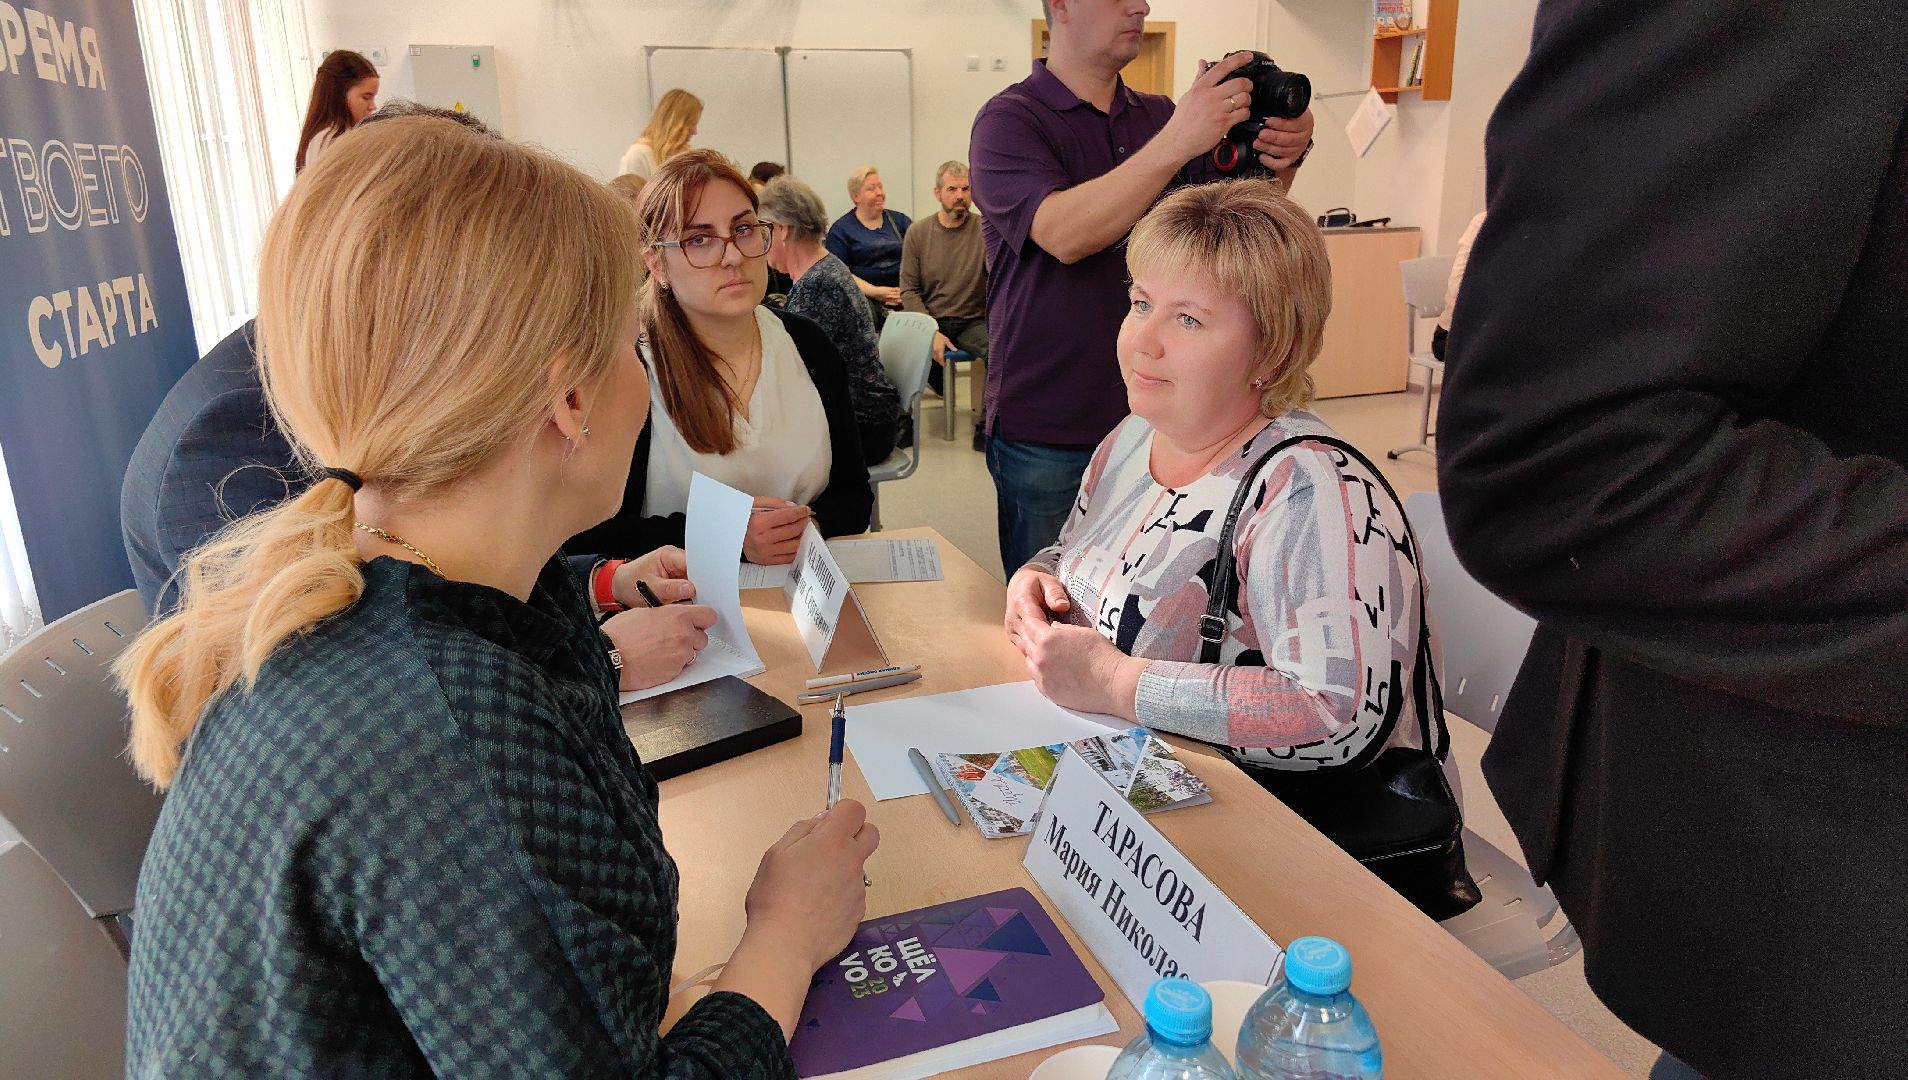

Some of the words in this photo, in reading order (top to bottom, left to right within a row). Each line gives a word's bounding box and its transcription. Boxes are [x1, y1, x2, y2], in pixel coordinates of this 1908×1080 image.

[0, 2, 106, 90] РЕМЯ
[28, 273, 159, 368] СТАРТА
[1043, 813, 1102, 900] Мария
[1092, 800, 1206, 944] ТАРАСОВА
[896, 936, 937, 984] ЩЁЛ
